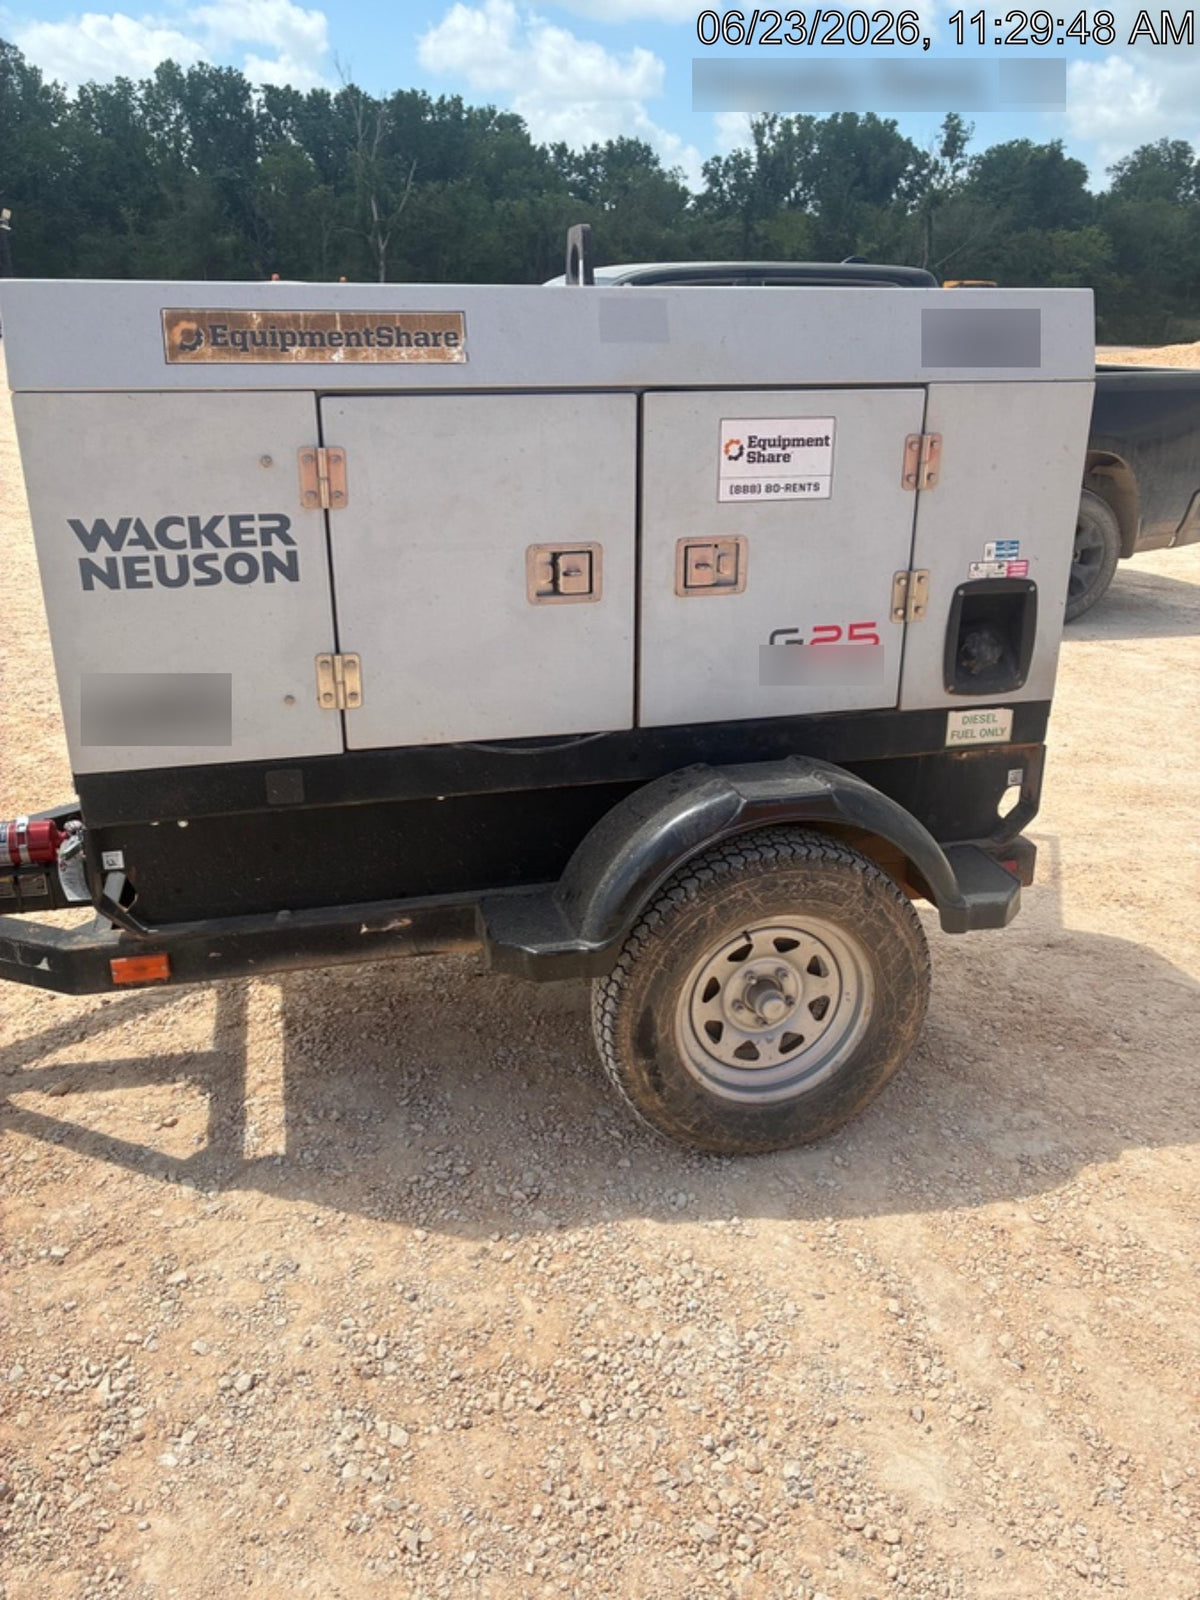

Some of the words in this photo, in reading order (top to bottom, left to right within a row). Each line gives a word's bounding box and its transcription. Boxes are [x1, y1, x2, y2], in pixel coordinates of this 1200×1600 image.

[208, 324, 460, 352] EquipmentShare
[747, 434, 831, 450] Equipment
[746, 451, 792, 464] Share
[729, 483, 762, 495] (888)
[764, 482, 820, 494] 80-RENTS
[66, 513, 298, 553] WACKER
[78, 550, 300, 591] NEUSON
[961, 712, 998, 726] DIESEL
[950, 728, 976, 740] FUEL
[979, 726, 1007, 739] ONLY
